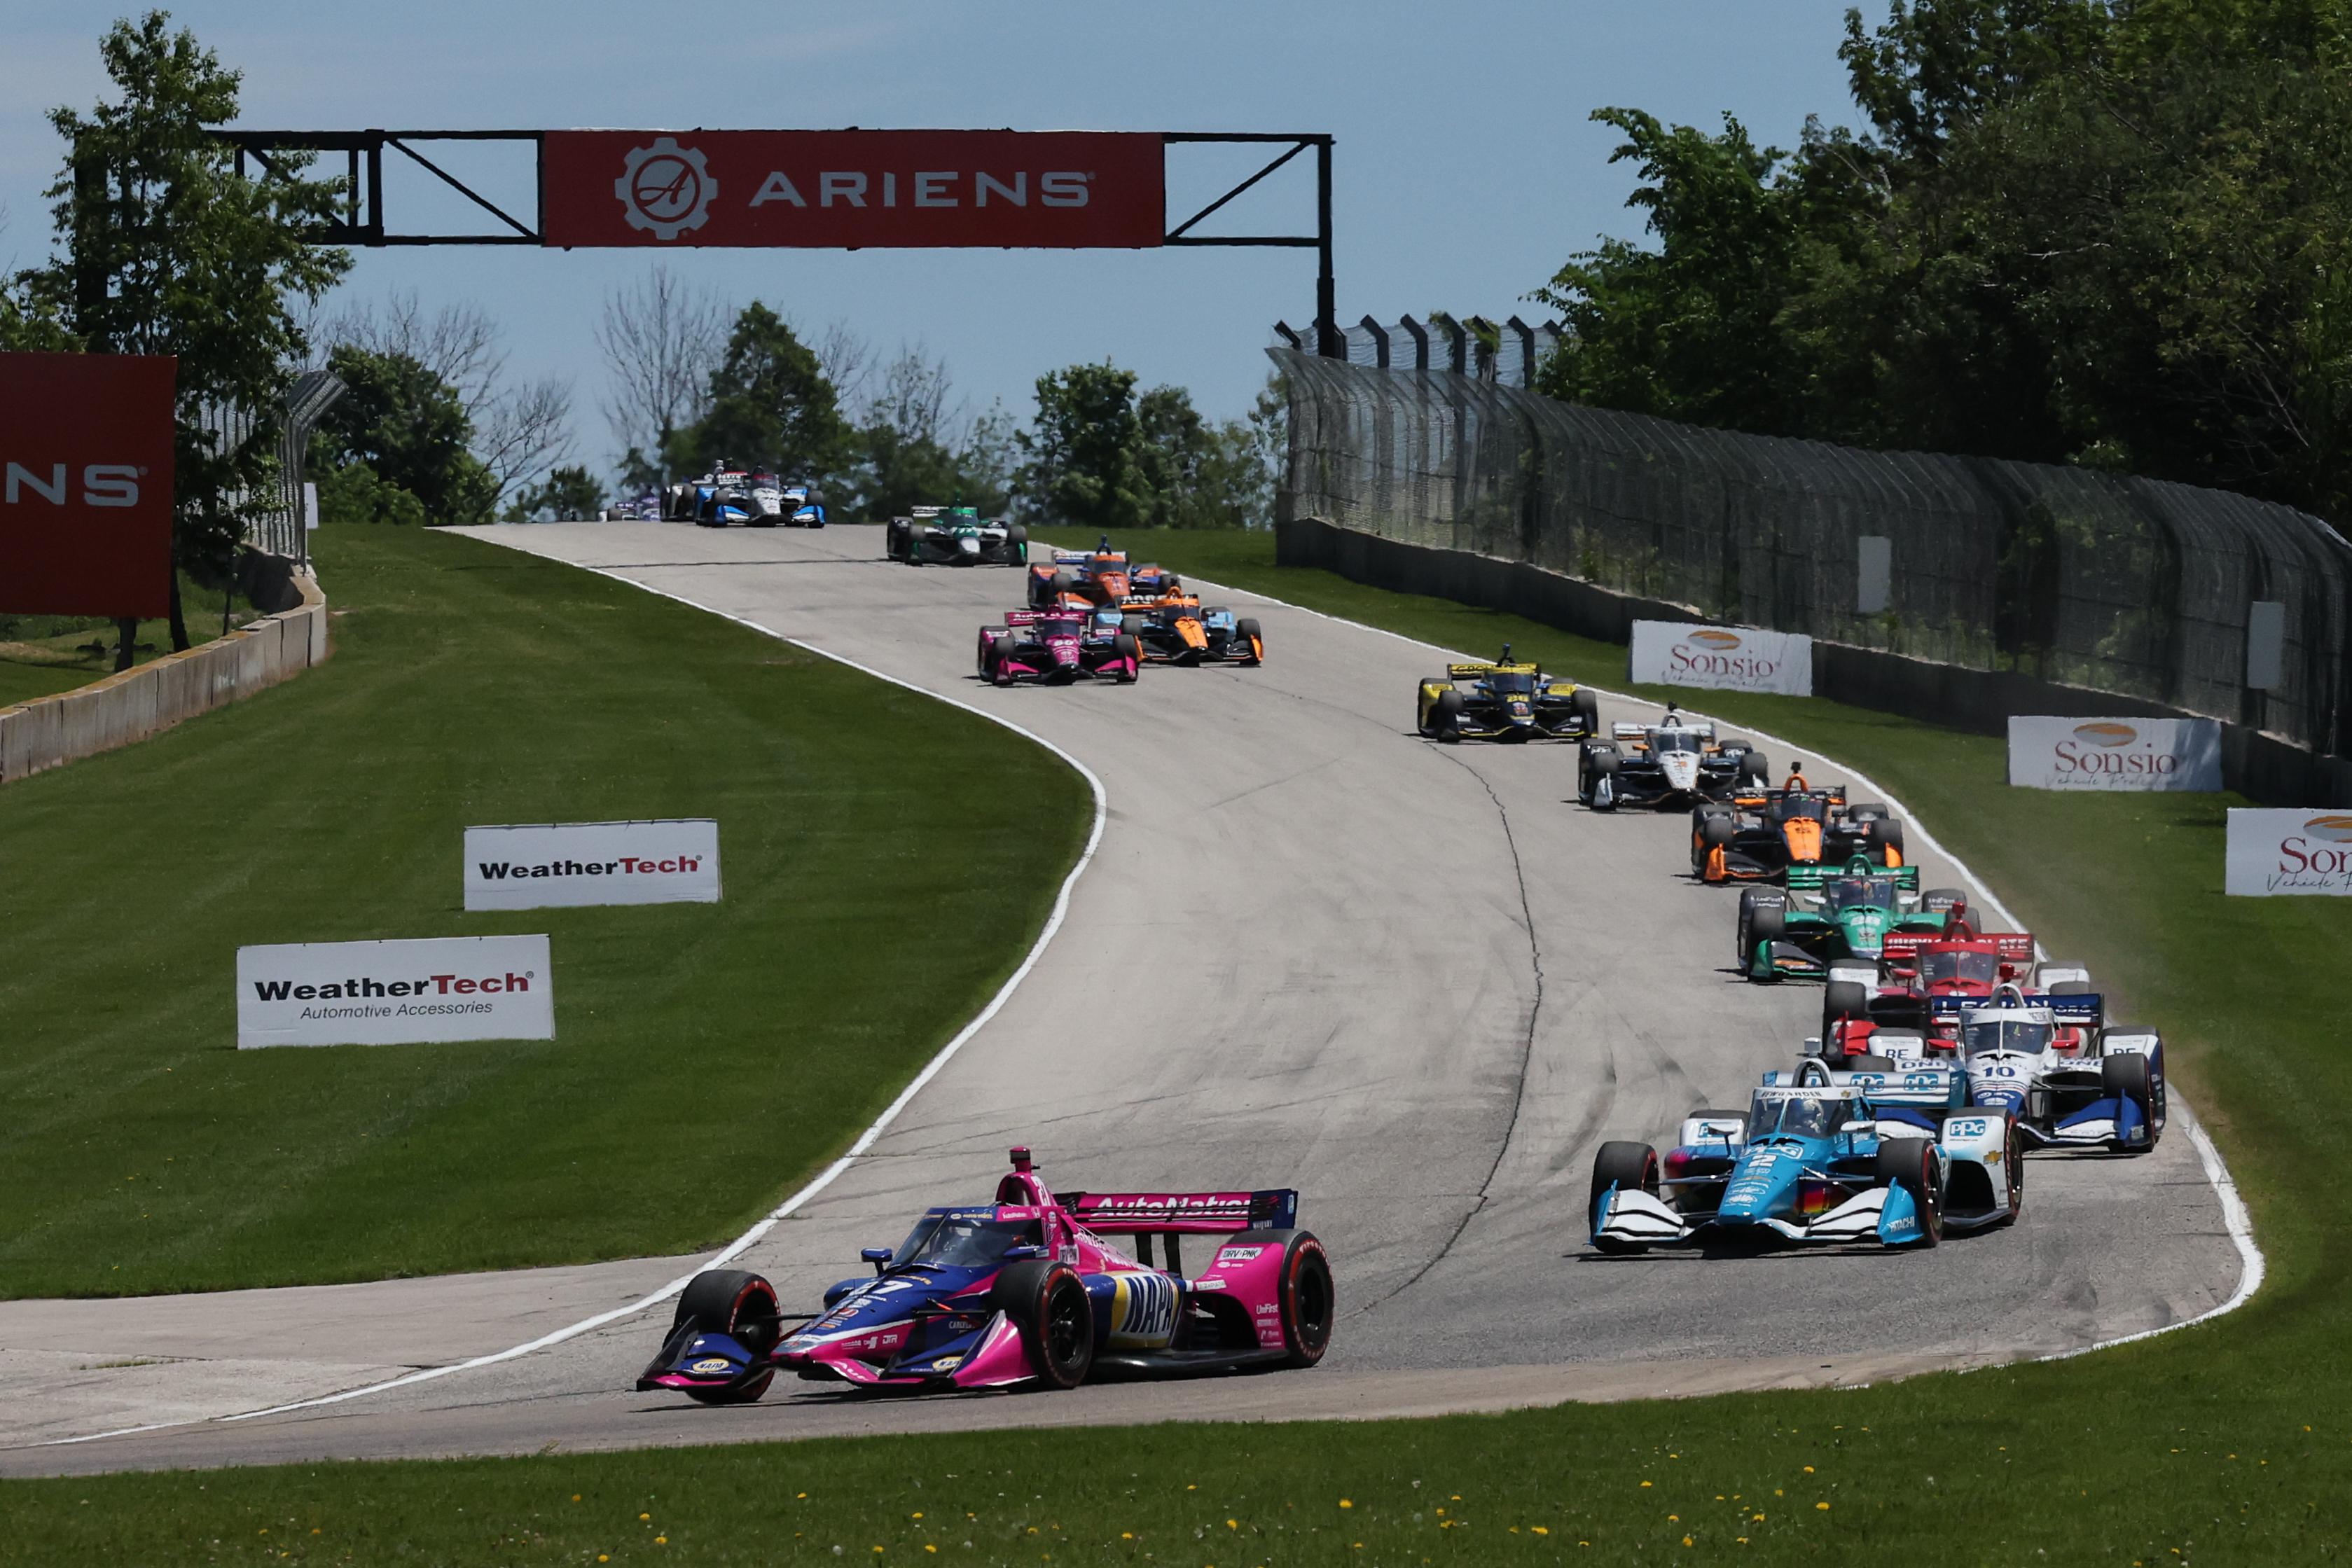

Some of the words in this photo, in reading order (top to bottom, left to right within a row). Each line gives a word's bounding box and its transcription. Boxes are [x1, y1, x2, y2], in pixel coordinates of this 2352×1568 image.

[749, 170, 1089, 208] ARIENS
[1670, 644, 1773, 677] Sonsio
[2055, 740, 2178, 774] Sonsio
[478, 856, 698, 880] WeatherTech
[254, 972, 529, 1001] WeatherTech
[300, 1004, 392, 1020] Automotive
[396, 1000, 493, 1017] Accessories
[1982, 1067, 2016, 1078] 10
[1951, 1122, 1986, 1135] PPG
[1748, 1155, 1777, 1167] 2
[1890, 1216, 1915, 1233] HITACHI
[1122, 1275, 1174, 1333] NAPA
[698, 1361, 725, 1370] NAPA
